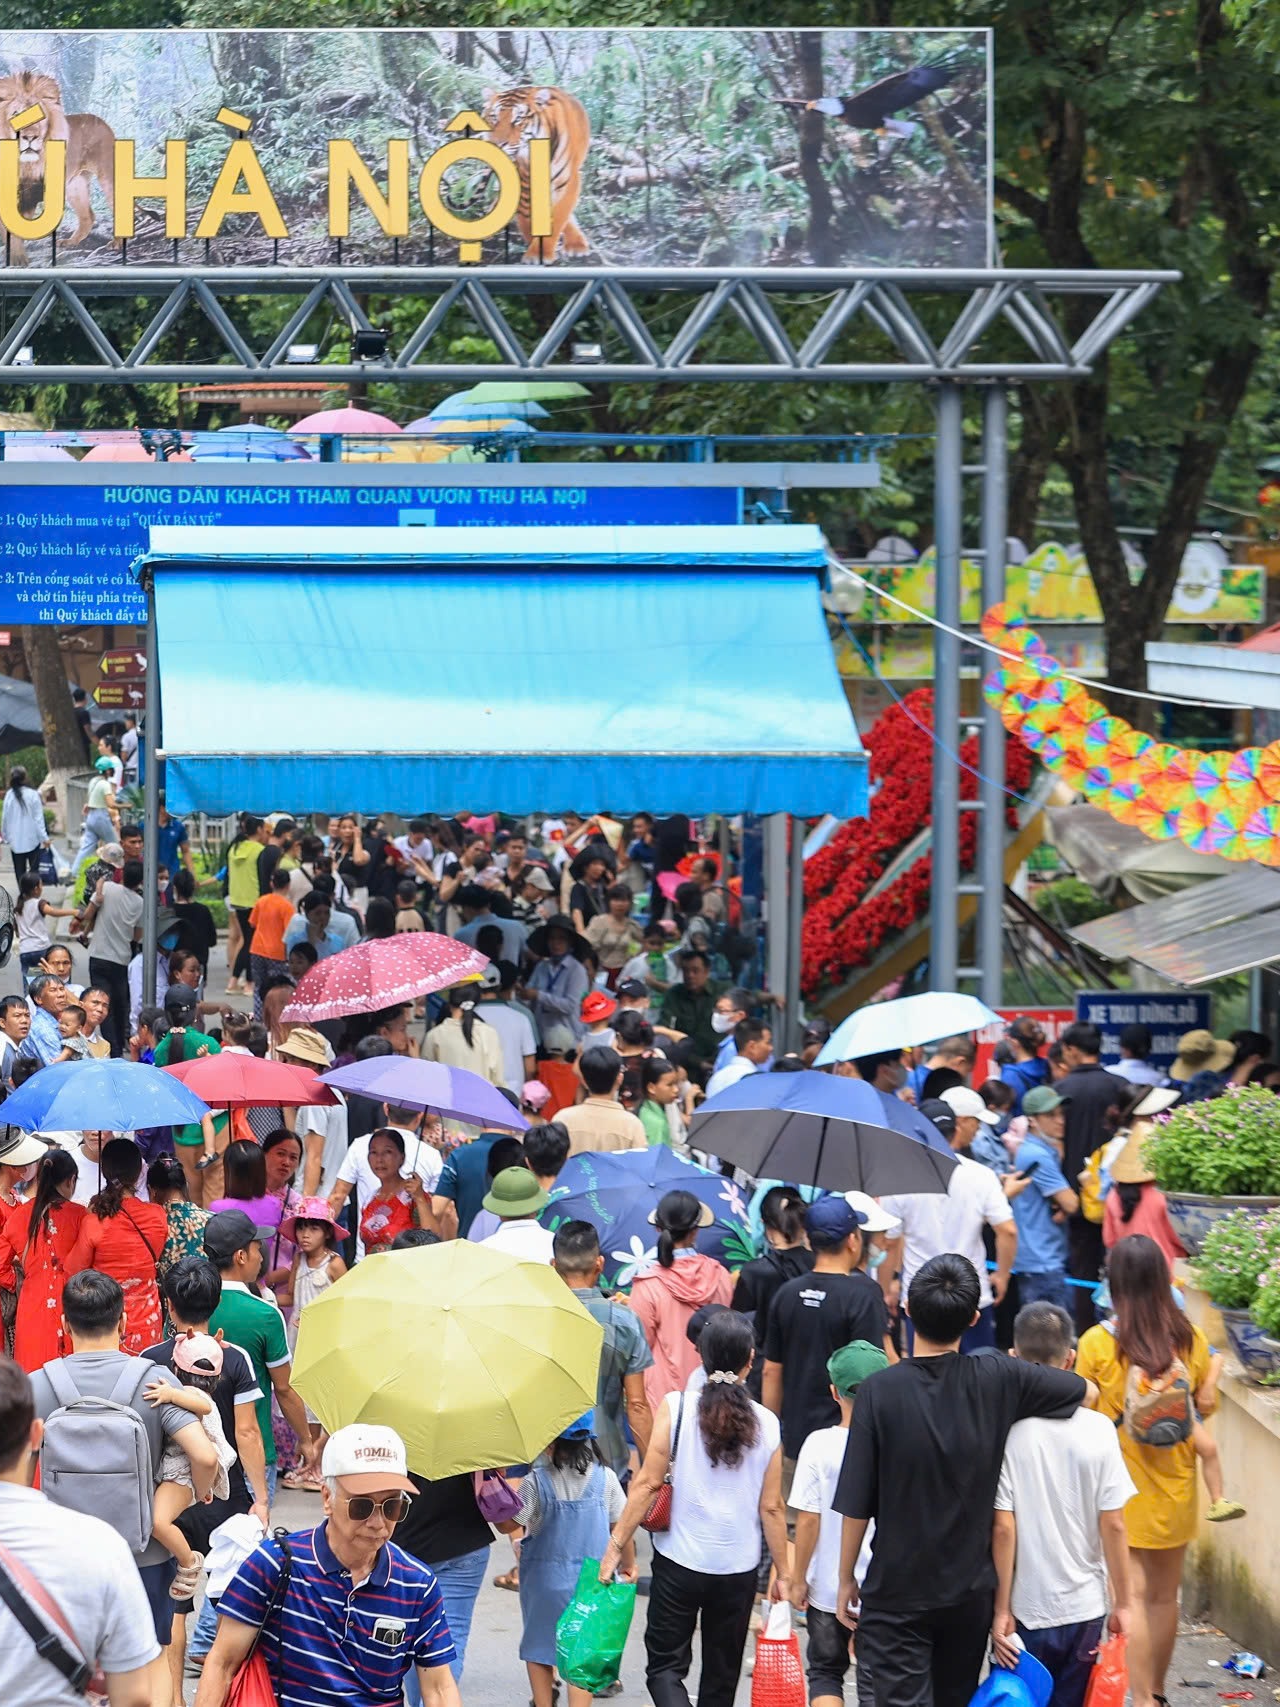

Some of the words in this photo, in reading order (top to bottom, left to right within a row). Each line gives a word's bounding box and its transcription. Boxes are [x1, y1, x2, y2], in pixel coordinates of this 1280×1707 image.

[113, 106, 289, 239] HÀ
[328, 110, 553, 263] NỘI
[296, 488, 351, 505] THAM
[356, 488, 412, 505] QUAN
[41, 514, 73, 526] khách
[76, 517, 98, 527] mua
[41, 543, 73, 556] khách
[80, 608, 113, 621] khách
